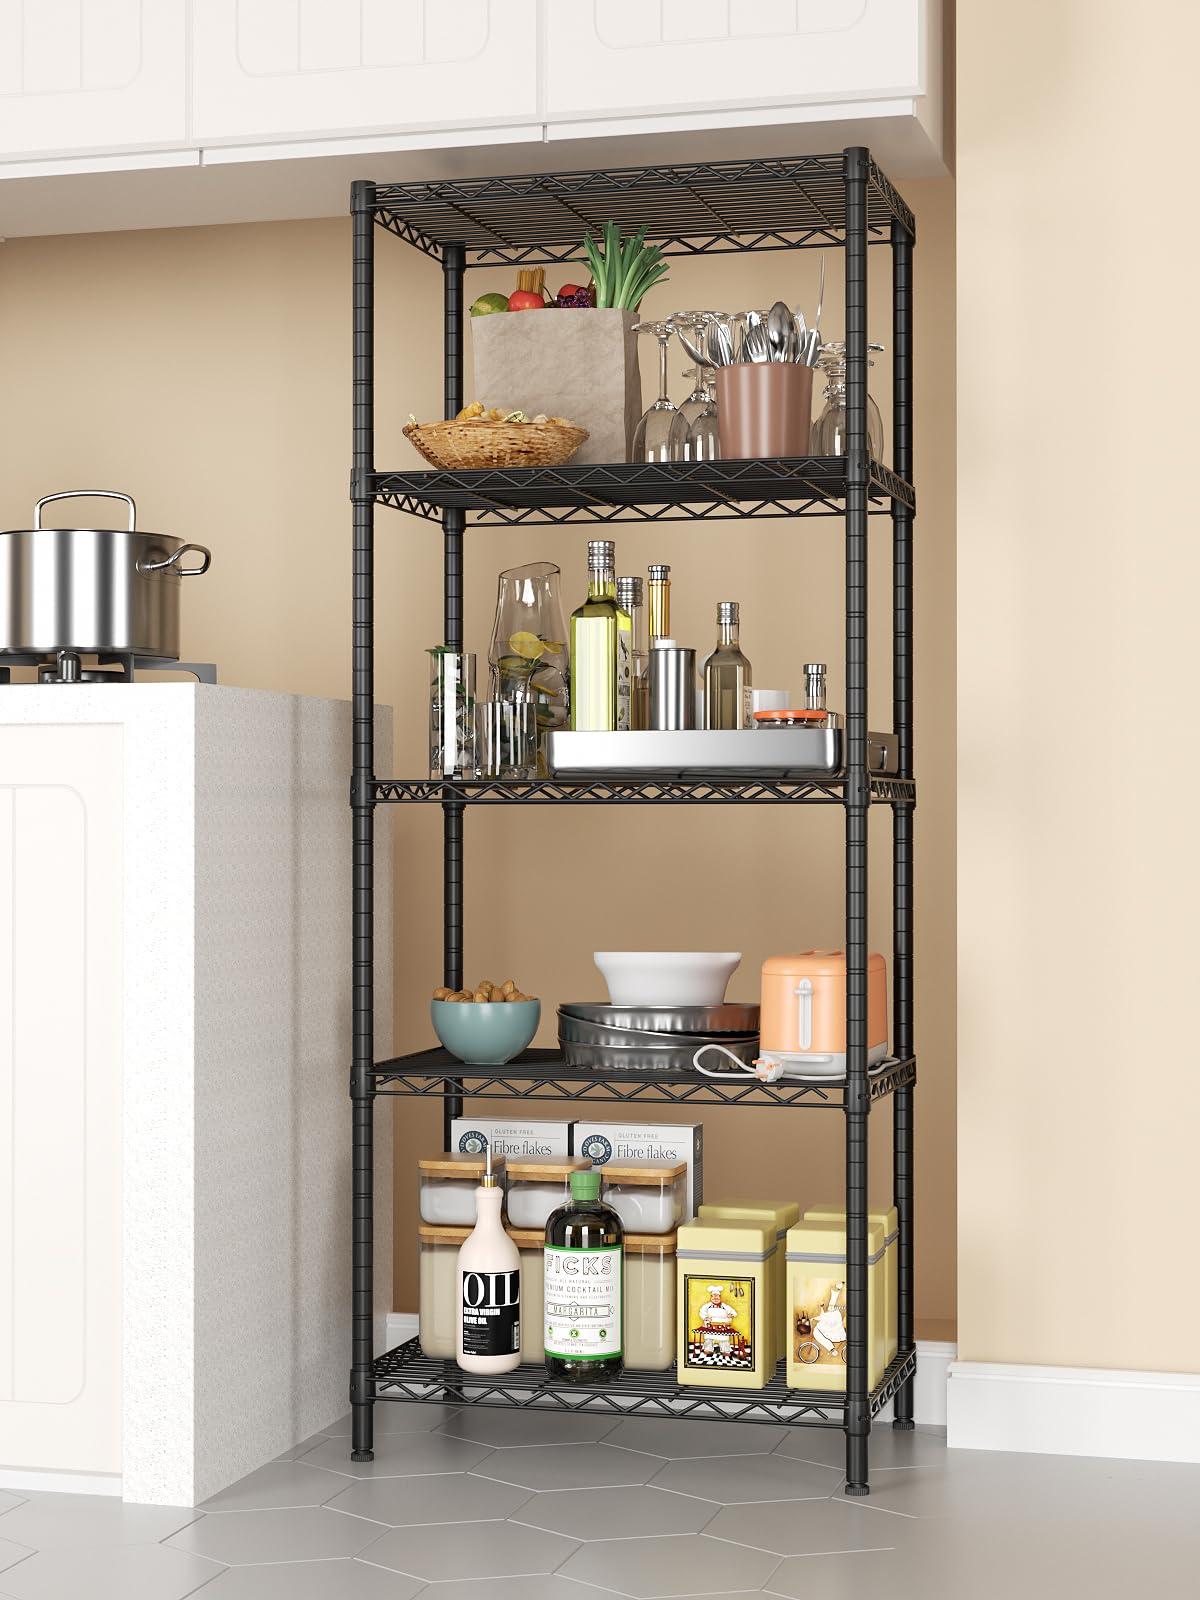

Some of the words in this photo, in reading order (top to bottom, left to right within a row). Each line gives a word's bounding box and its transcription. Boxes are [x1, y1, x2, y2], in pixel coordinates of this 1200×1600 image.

[494, 1140, 520, 1155] Fibre
[522, 1141, 552, 1156] flakes
[617, 1143, 643, 1159] Fibre
[646, 1144, 677, 1160] flakes
[546, 1253, 612, 1275] FICKS
[463, 1272, 519, 1307] OIL
[463, 1307, 480, 1316] EXTRA
[479, 1308, 501, 1316] VIRGIN
[553, 1306, 599, 1316] MARGARITA
[463, 1316, 478, 1325] OLIVE
[478, 1317, 488, 1325] OIL
